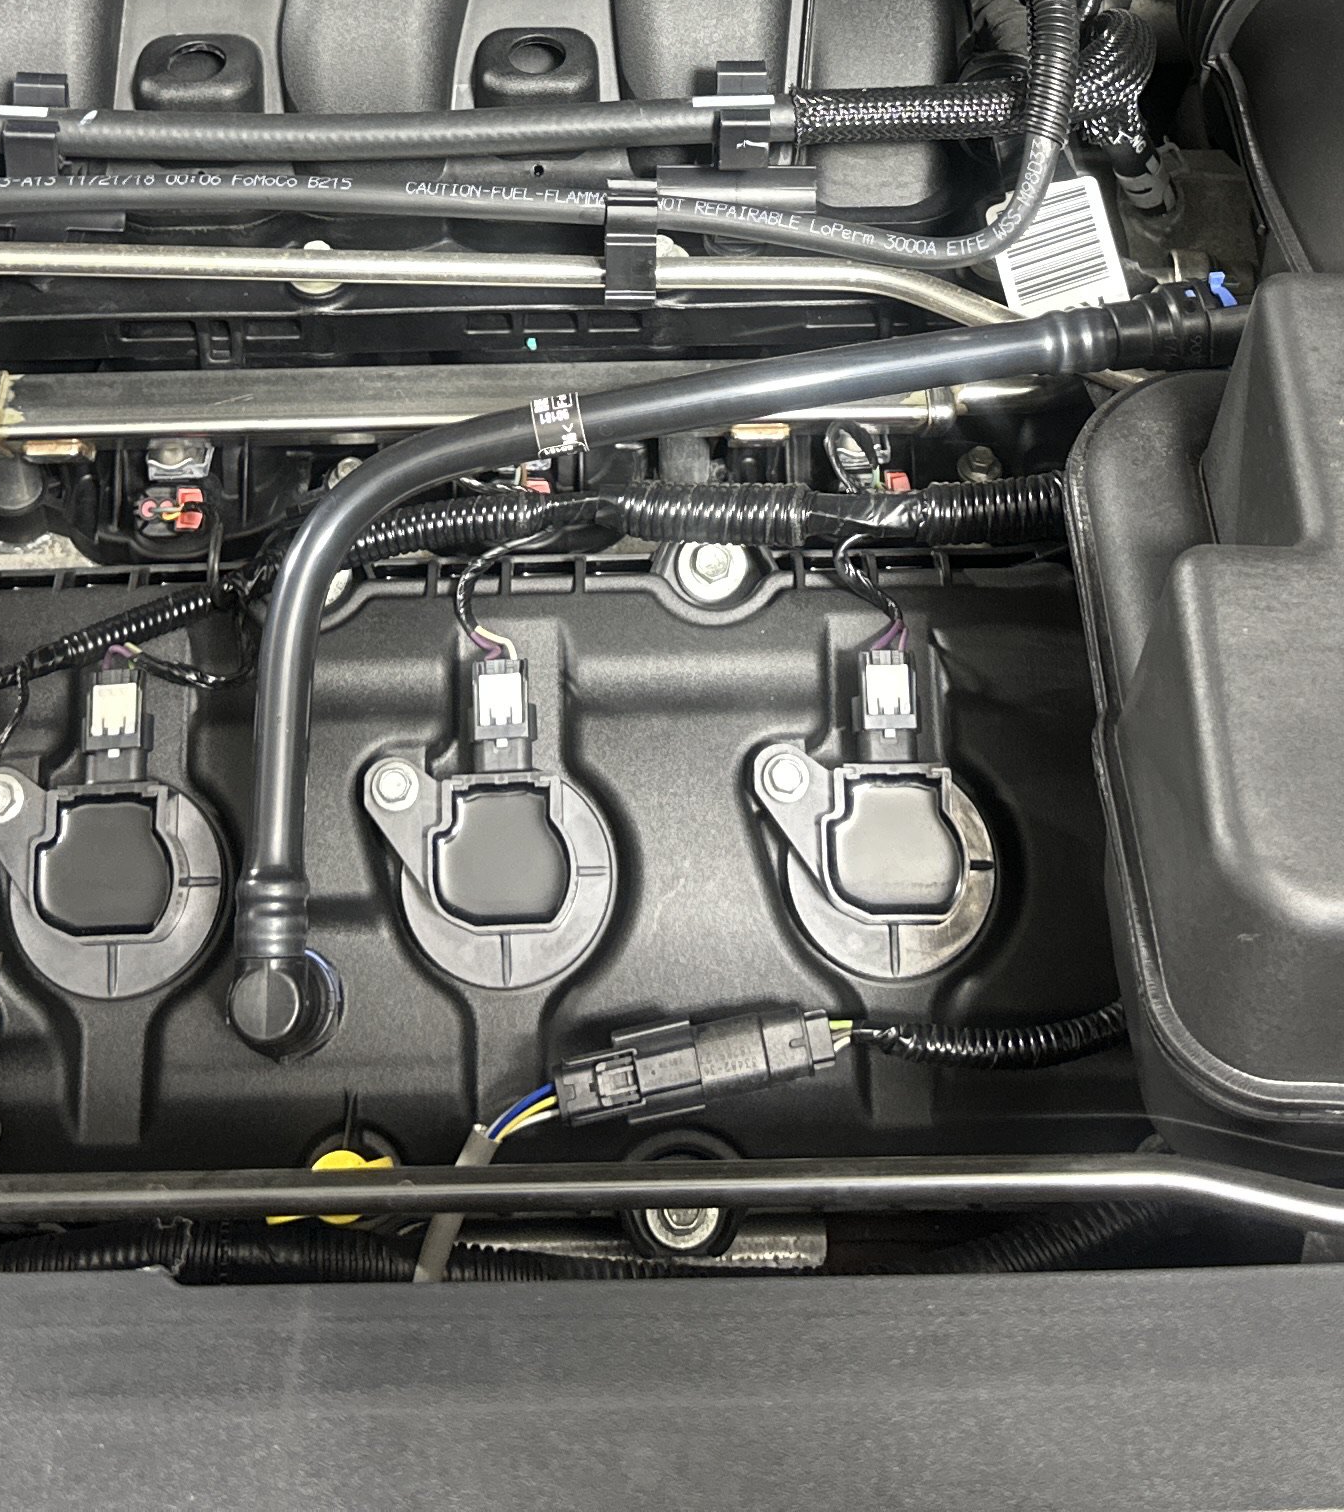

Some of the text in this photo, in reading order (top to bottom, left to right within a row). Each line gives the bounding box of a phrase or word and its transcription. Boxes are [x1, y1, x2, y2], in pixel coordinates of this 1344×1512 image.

[165, 174, 222, 186] 00:06
[231, 174, 298, 187] FoMoCo
[308, 176, 354, 190] B215
[695, 200, 801, 232] REPAIRABLE
[809, 218, 875, 245] LoPerm
[884, 233, 937, 257] 3000A
[947, 234, 990, 257] ETFE
